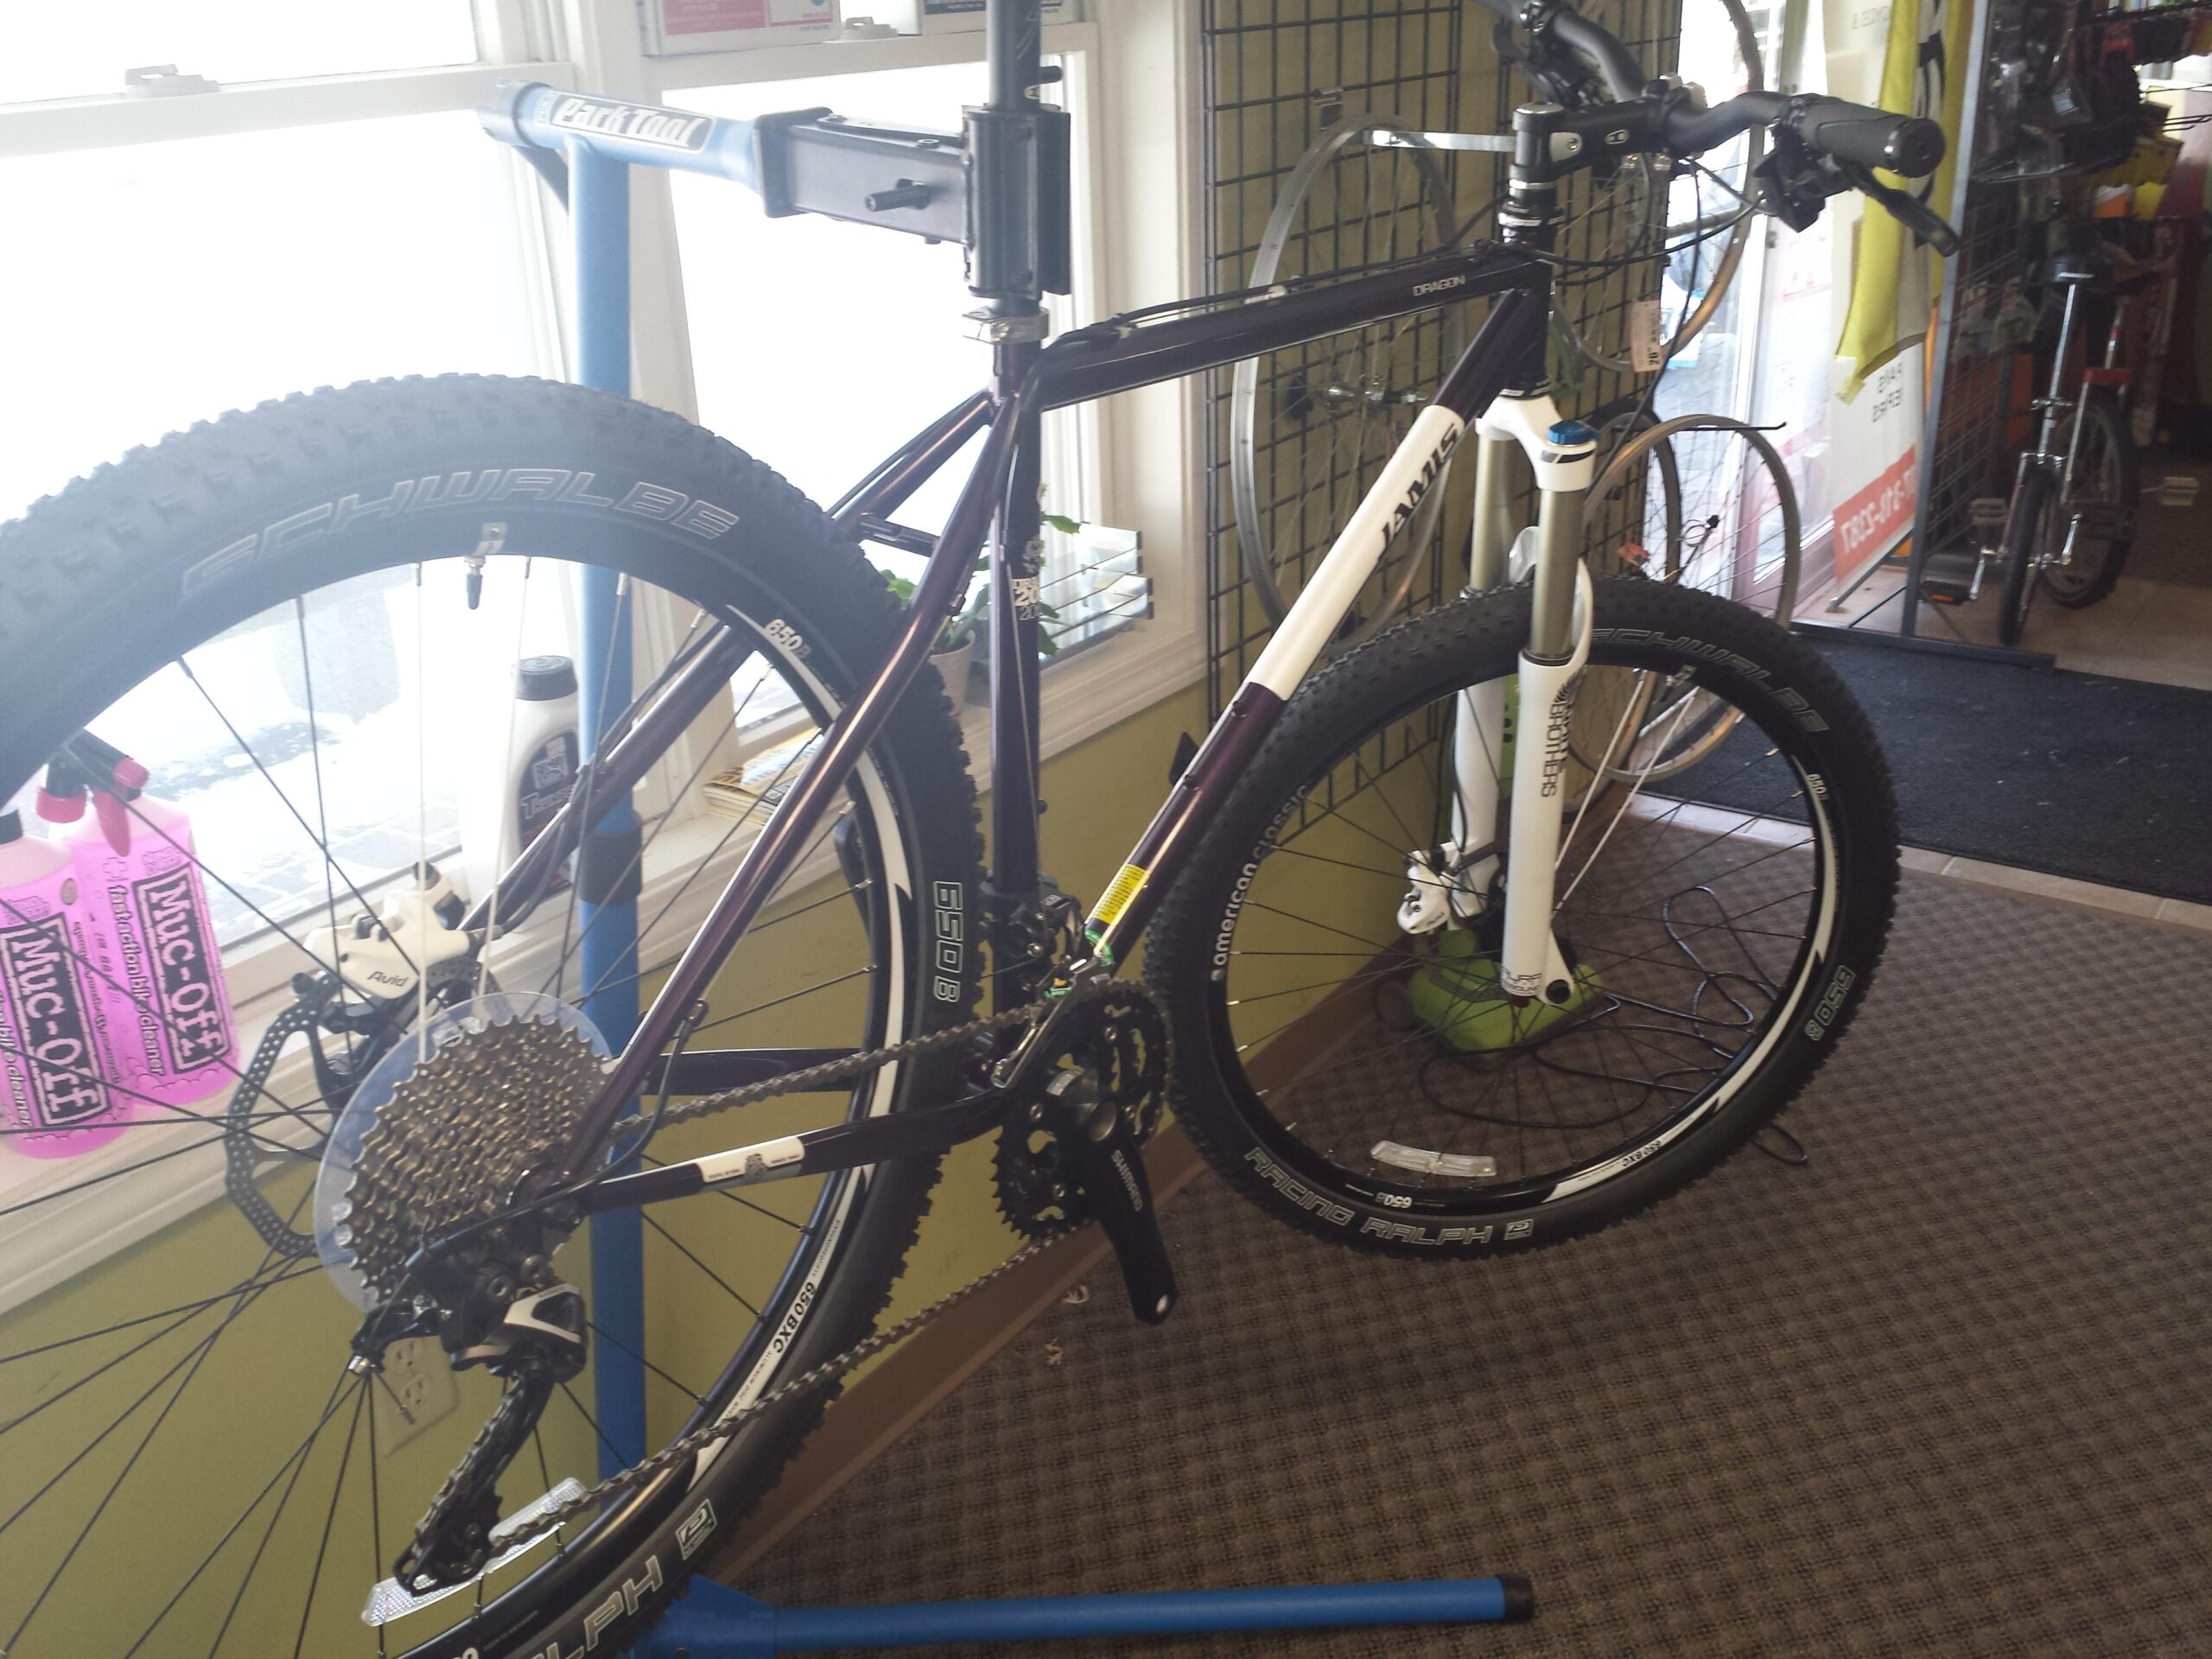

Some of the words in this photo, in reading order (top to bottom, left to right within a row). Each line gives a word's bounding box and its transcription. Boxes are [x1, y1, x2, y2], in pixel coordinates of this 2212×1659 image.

[561, 98, 630, 135] Park
[627, 108, 706, 149] Tool
[1412, 275, 1466, 296] DRAGON
[181, 468, 741, 596] SCHWALBE
[765, 619, 812, 661] 650B
[1541, 702, 1567, 798] BROTHERS
[1213, 862, 1259, 966] american
[1252, 784, 1308, 860] classic
[148, 877, 224, 1058] Muc-Off
[366, 970, 410, 988] Avid
[10, 931, 100, 1114] Muc-Off
[1111, 1149, 1143, 1211] SHIMANO
[1244, 1147, 1356, 1227] RACING
[1360, 1216, 1494, 1246] RALPH
